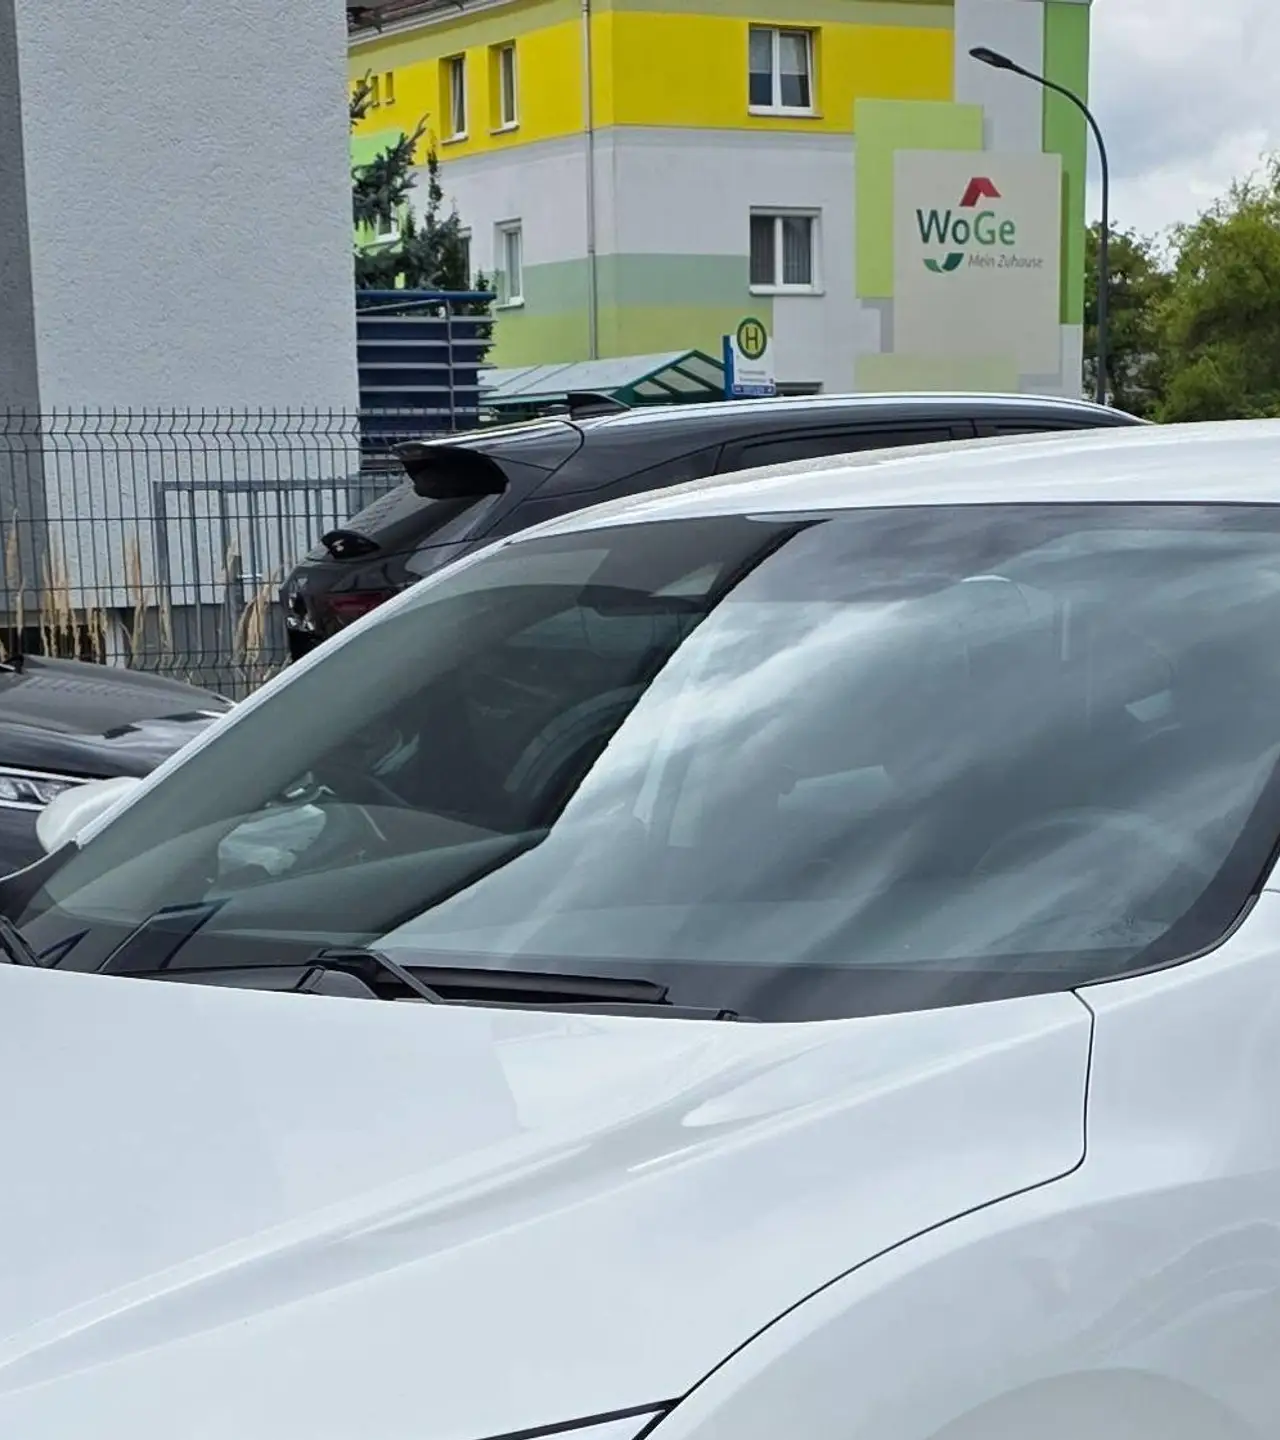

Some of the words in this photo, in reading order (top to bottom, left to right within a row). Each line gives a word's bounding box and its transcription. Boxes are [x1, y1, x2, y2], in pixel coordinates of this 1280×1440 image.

[916, 209, 1016, 245] WoGe
[967, 253, 996, 269] Mein
[745, 326, 759, 351] H
